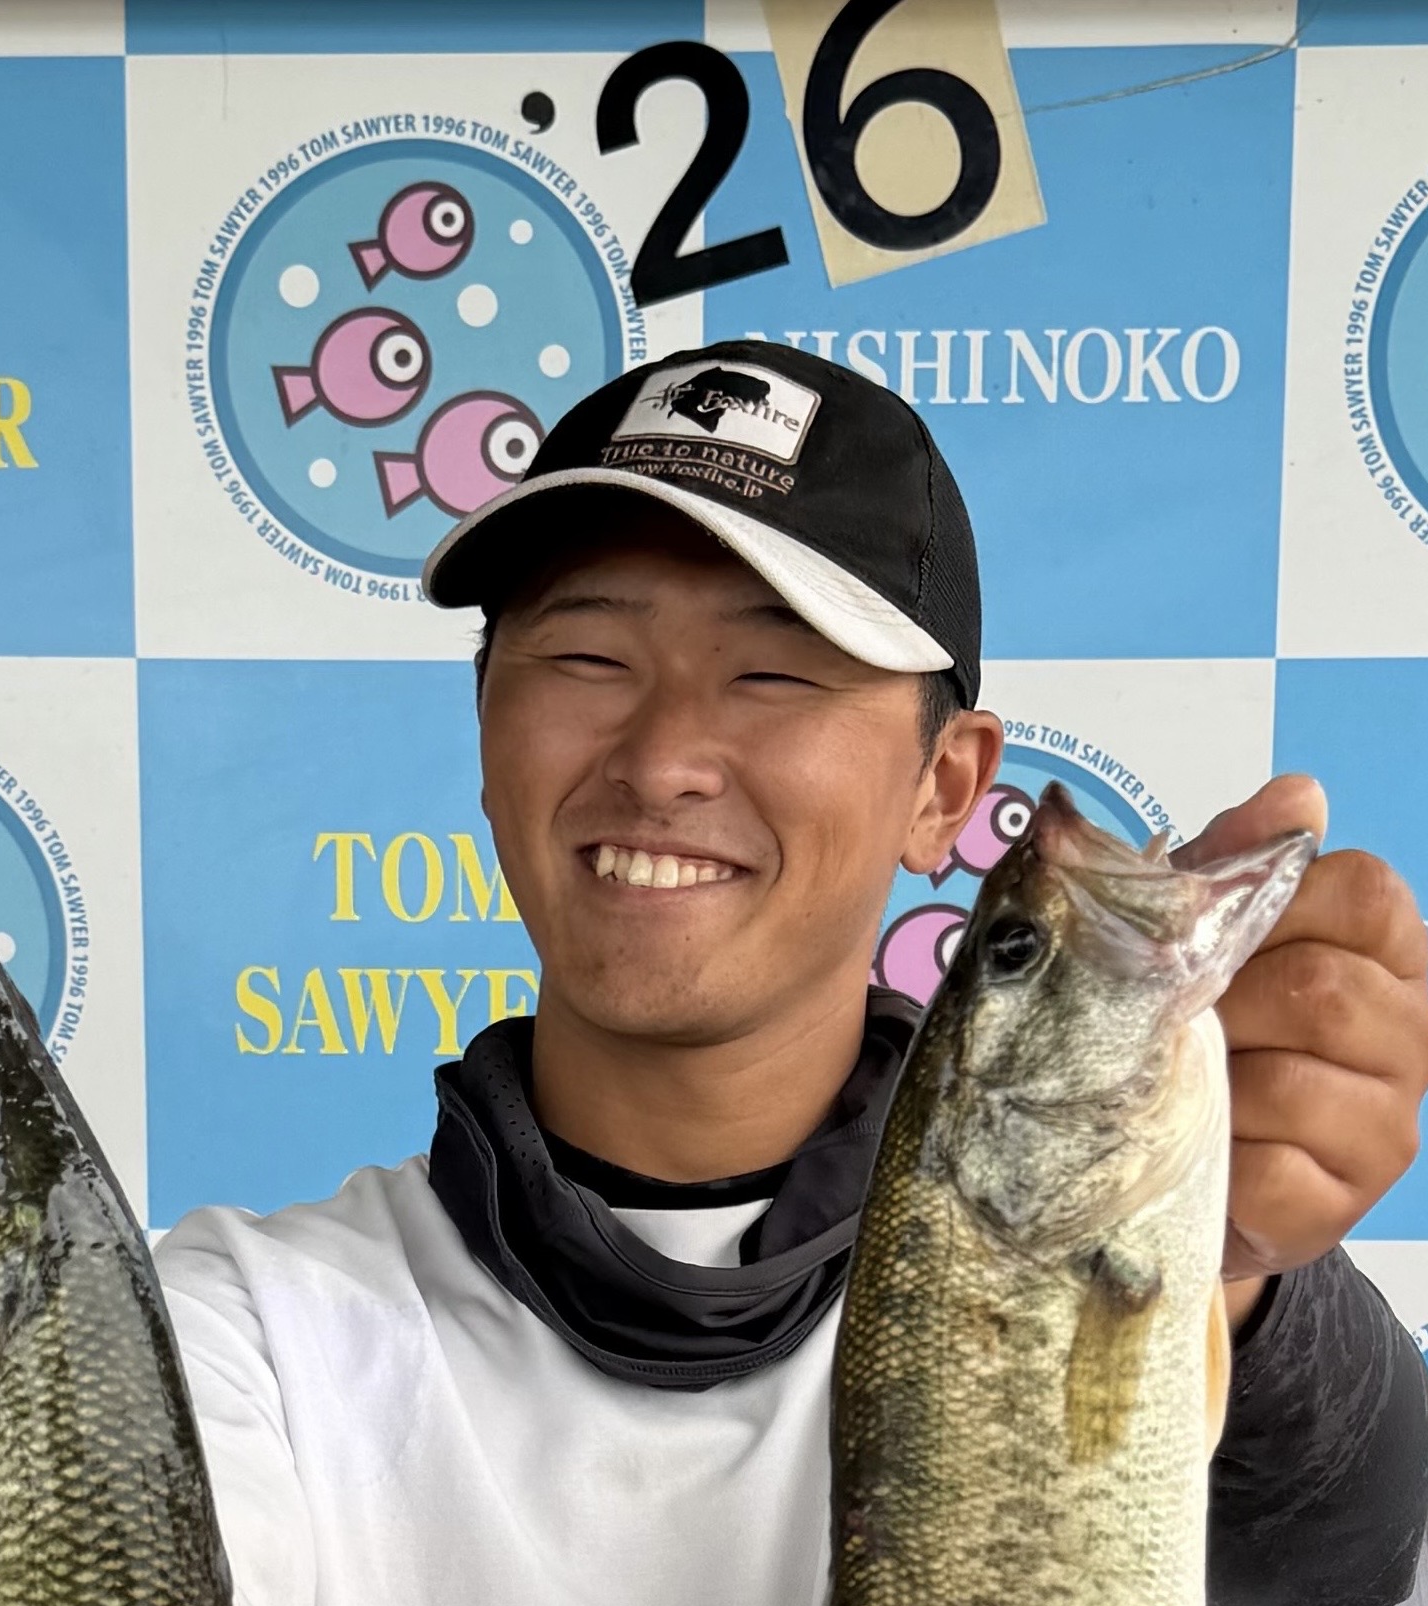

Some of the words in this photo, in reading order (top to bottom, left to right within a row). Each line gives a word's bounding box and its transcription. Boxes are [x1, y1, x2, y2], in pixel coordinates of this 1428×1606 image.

[296, 129, 340, 162] TOM
[339, 112, 417, 145] SAWYER
[420, 113, 467, 138] 1996
[469, 119, 510, 152] TOM
[257, 152, 300, 192] 1996
[508, 138, 578, 198] SAWYER
[208, 186, 264, 260] SAWYER
[573, 191, 611, 238] 1996
[191, 258, 221, 300] TOM
[601, 233, 635, 280] TOM
[1353, 250, 1386, 294] TOM
[184, 304, 208, 352] 1996
[1344, 298, 1369, 346] 1996
[663, 441, 692, 458] to
[701, 444, 796, 489] nature
[1004, 719, 1036, 740] 996
[1040, 725, 1078, 755] TOM
[1078, 743, 1145, 801] SAWYER
[13, 788, 51, 833] 1996
[41, 828, 72, 873] TOM
[313, 832, 521, 923] TOM
[58, 872, 90, 949] SAWYER
[67, 953, 89, 998] 1996
[55, 1001, 84, 1041] TOM
[235, 965, 540, 1055] SAWYE
